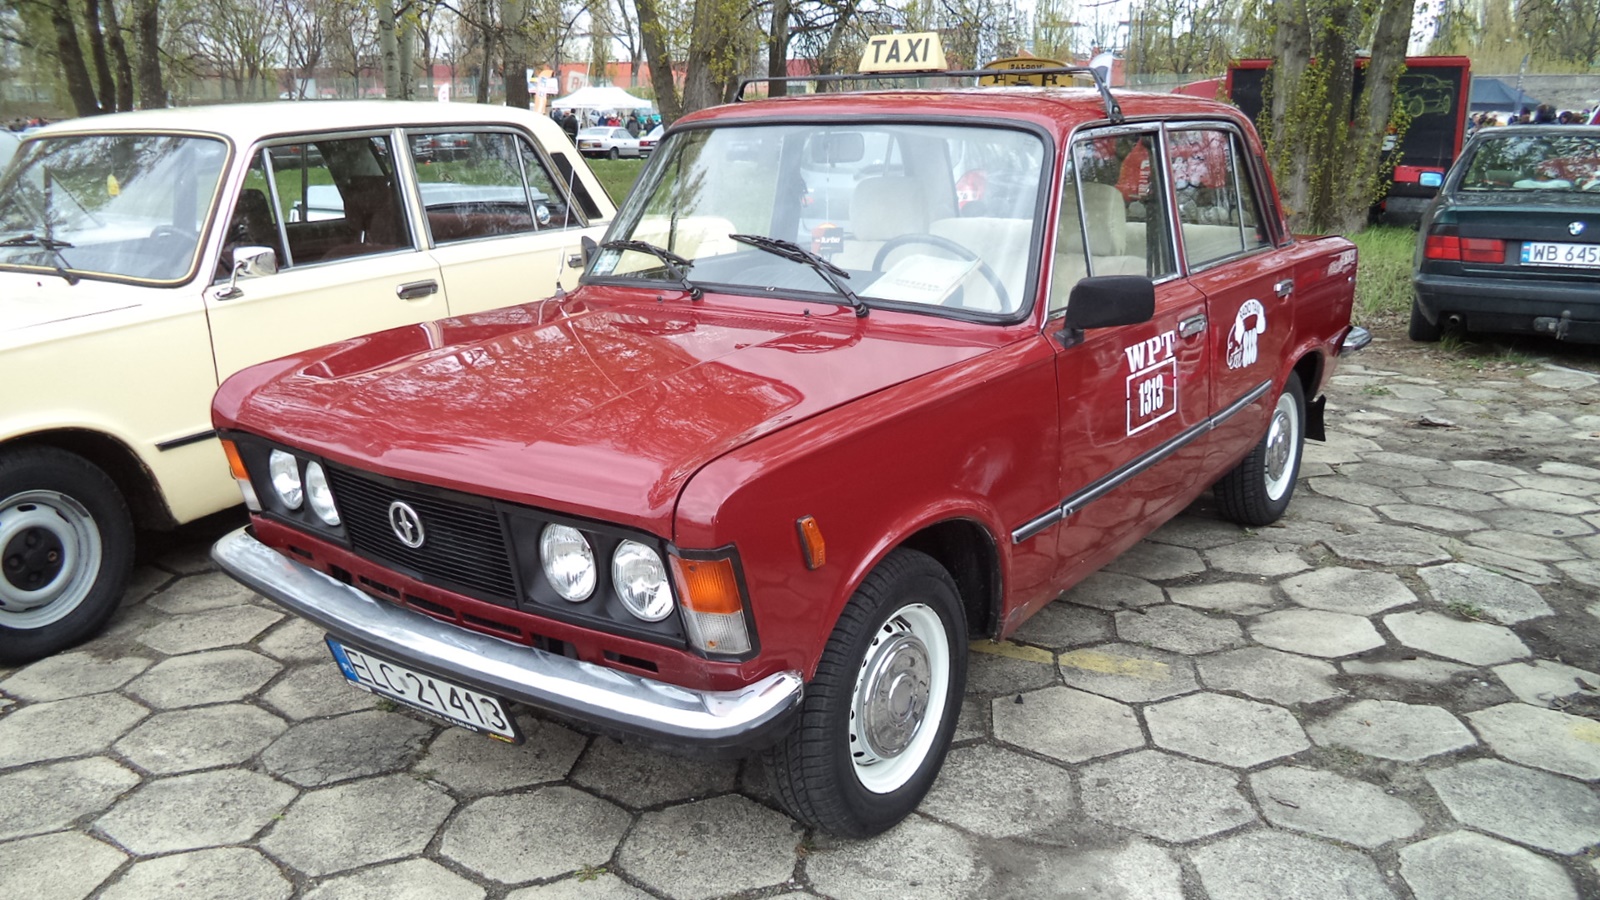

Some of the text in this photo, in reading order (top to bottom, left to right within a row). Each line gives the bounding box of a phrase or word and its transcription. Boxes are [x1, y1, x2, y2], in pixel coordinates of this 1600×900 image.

[871, 38, 930, 63] TAXI
[1533, 245, 1558, 261] WB
[1564, 246, 1600, 263] 645
[1124, 330, 1176, 373] WPT
[1138, 373, 1164, 417] 1313
[344, 650, 405, 695] ELC
[405, 672, 507, 731] 21413
